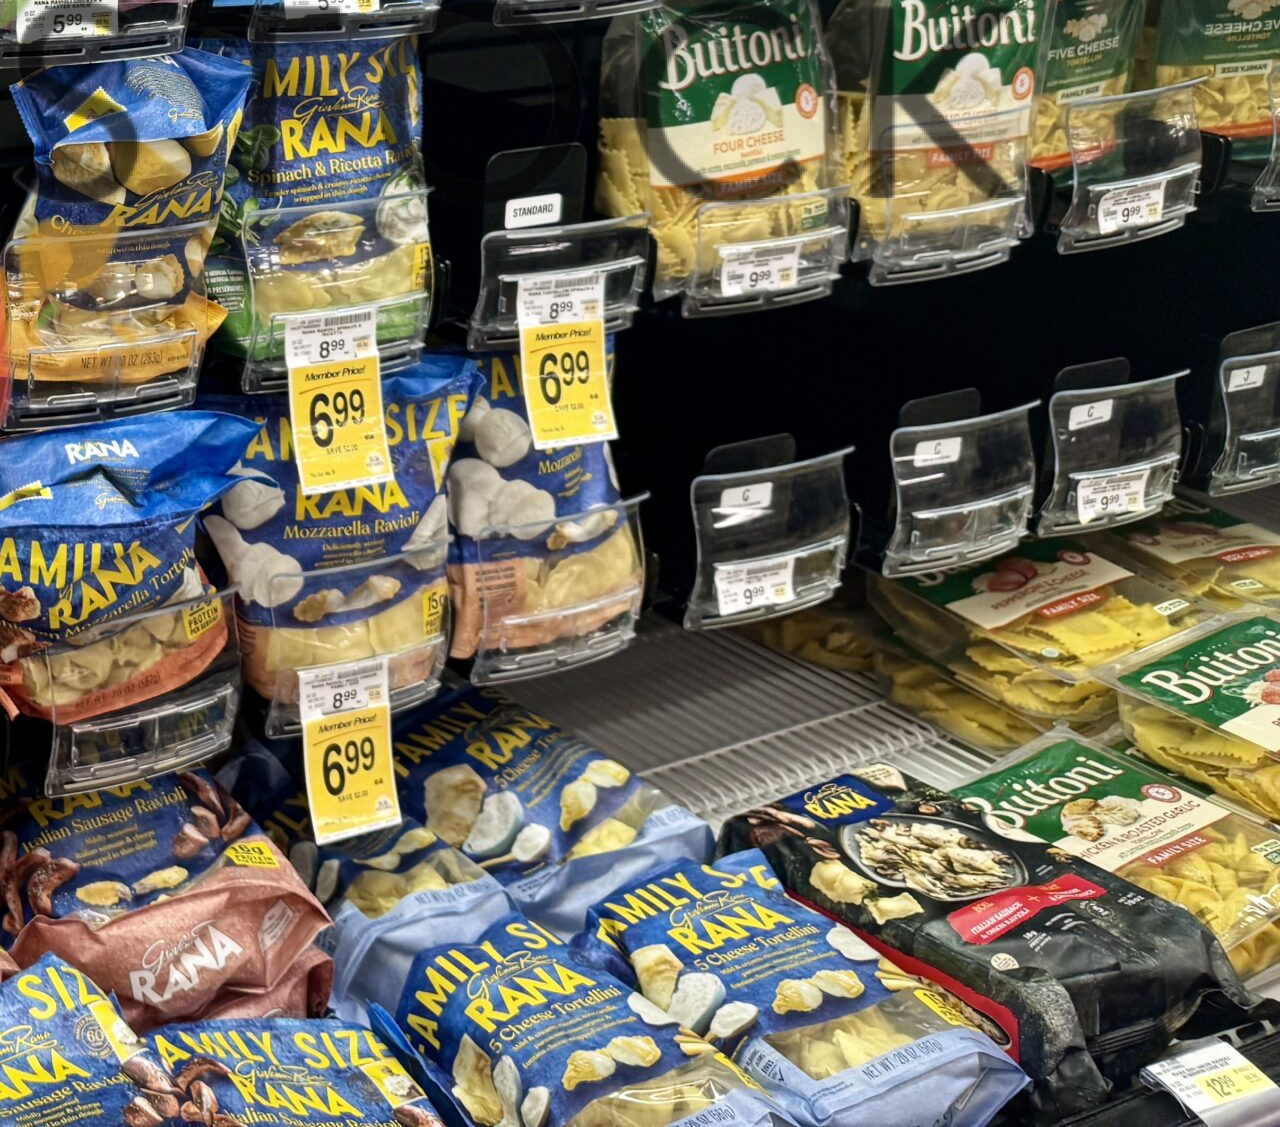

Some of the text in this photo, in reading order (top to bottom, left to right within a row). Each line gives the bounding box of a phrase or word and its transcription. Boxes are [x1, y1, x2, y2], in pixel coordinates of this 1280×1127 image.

[660, 17, 805, 91] Buitoni
[281, 115, 396, 160] RANA
[513, 203, 554, 217] STANDARD
[65, 438, 140, 464] RANA
[284, 511, 419, 539] Mozzarella Ravioli
[23, 786, 188, 853] Italian Sausage Ravioli
[130, 925, 243, 1003] RANA
[465, 962, 595, 1034] RANA
